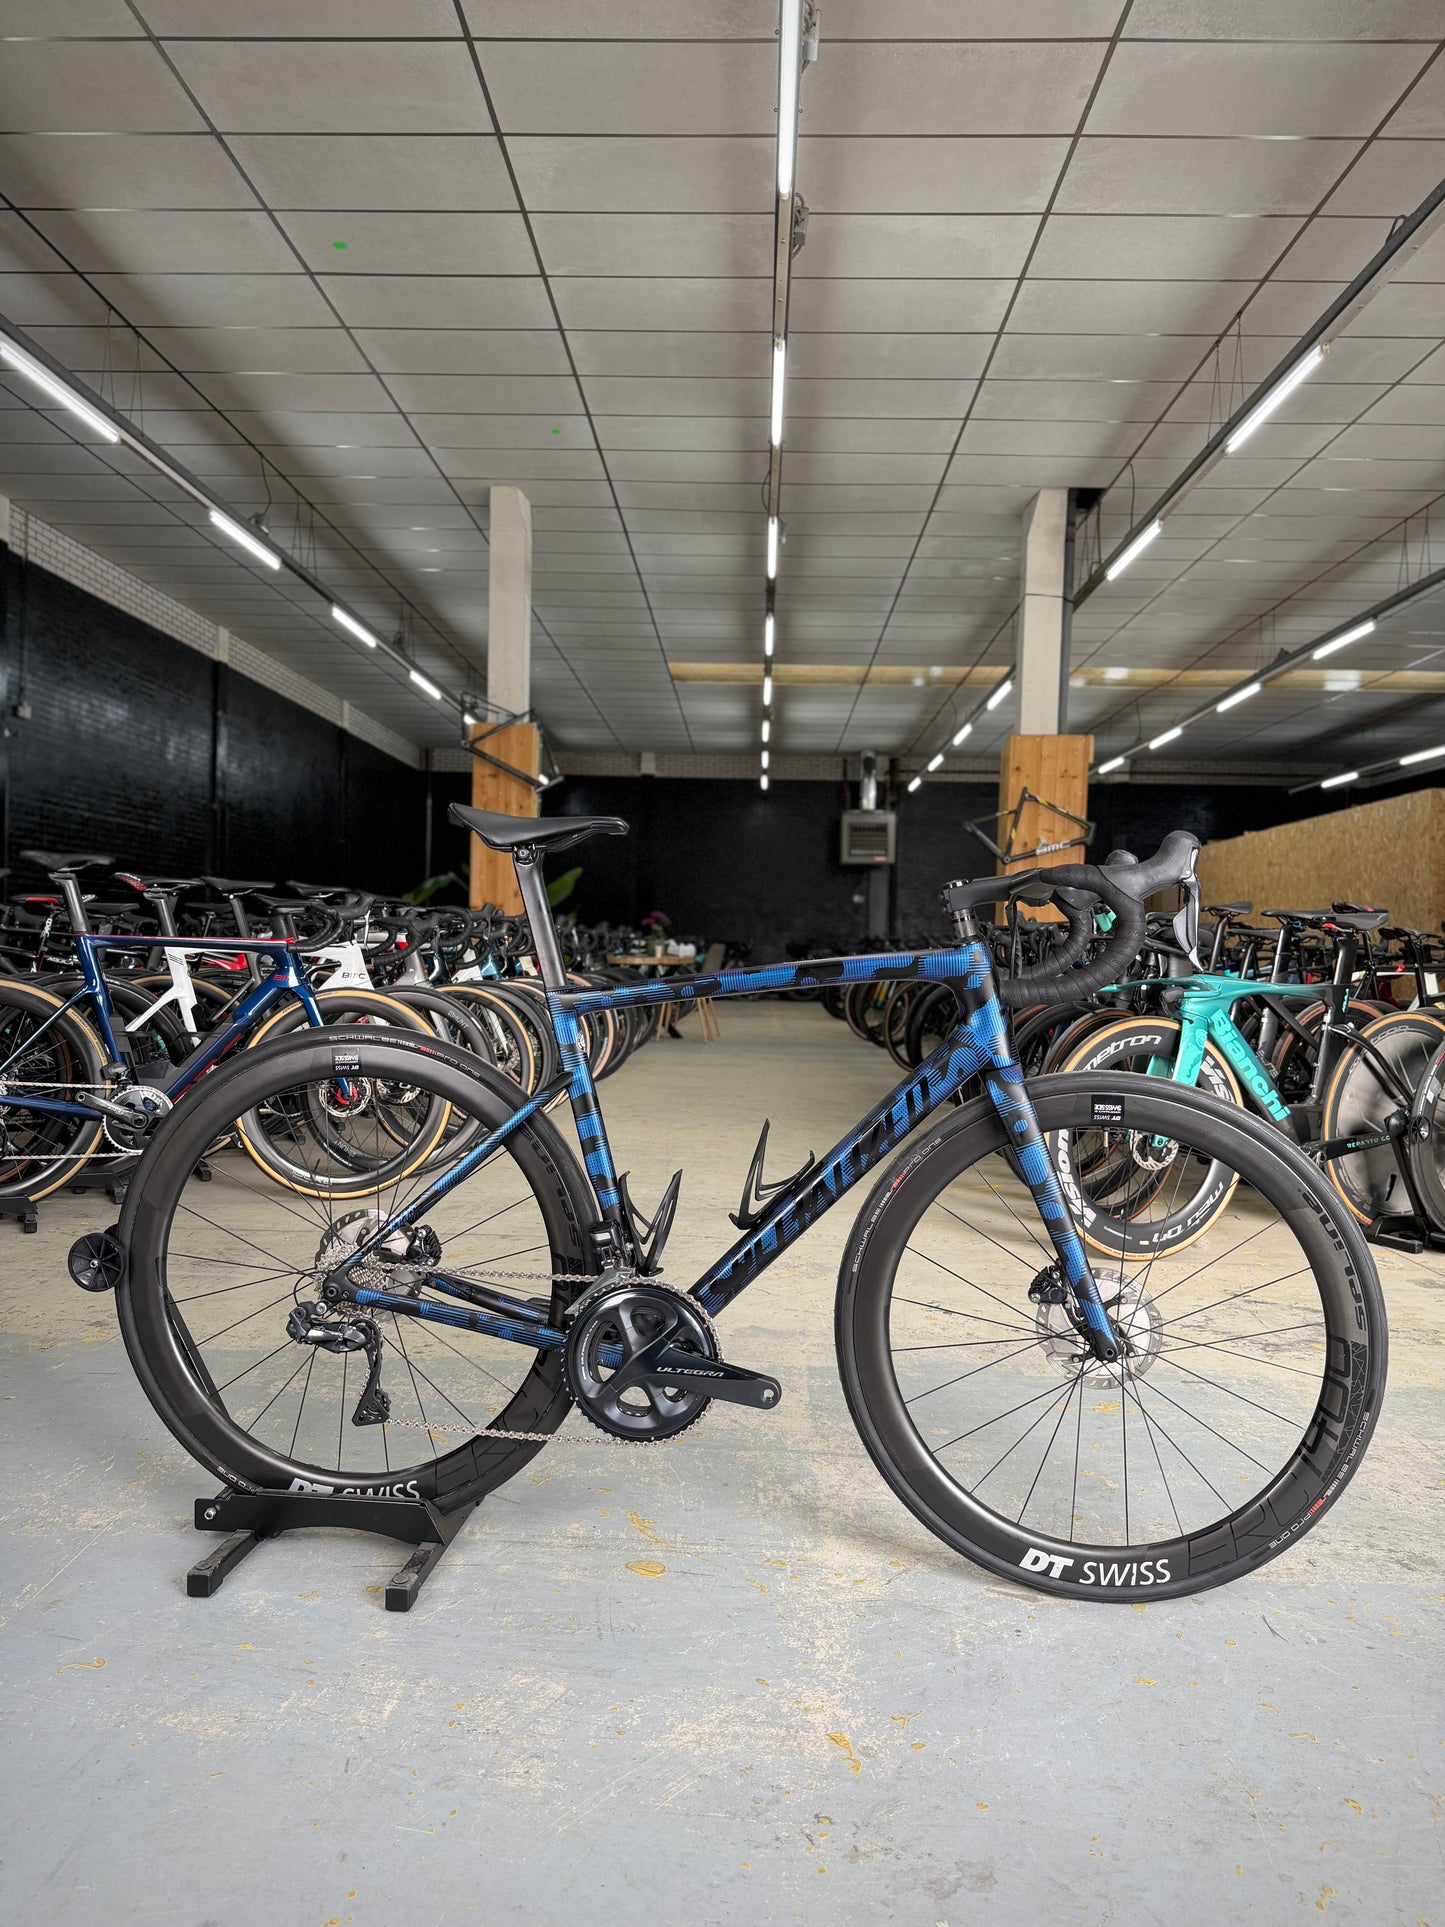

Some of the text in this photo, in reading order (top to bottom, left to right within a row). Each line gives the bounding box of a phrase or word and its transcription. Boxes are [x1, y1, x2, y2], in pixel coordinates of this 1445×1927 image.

[328, 1034, 400, 1045] SCHWALBE
[1211, 1009, 1292, 1122] Bianchi
[1346, 1137, 1379, 1149] REPARTO
[851, 1208, 881, 1273] SCHWALBE
[656, 1366, 725, 1378] ULTEGRA
[1336, 1411, 1370, 1479] SCHWALBE
[1018, 1547, 1171, 1587] DT SWISS
